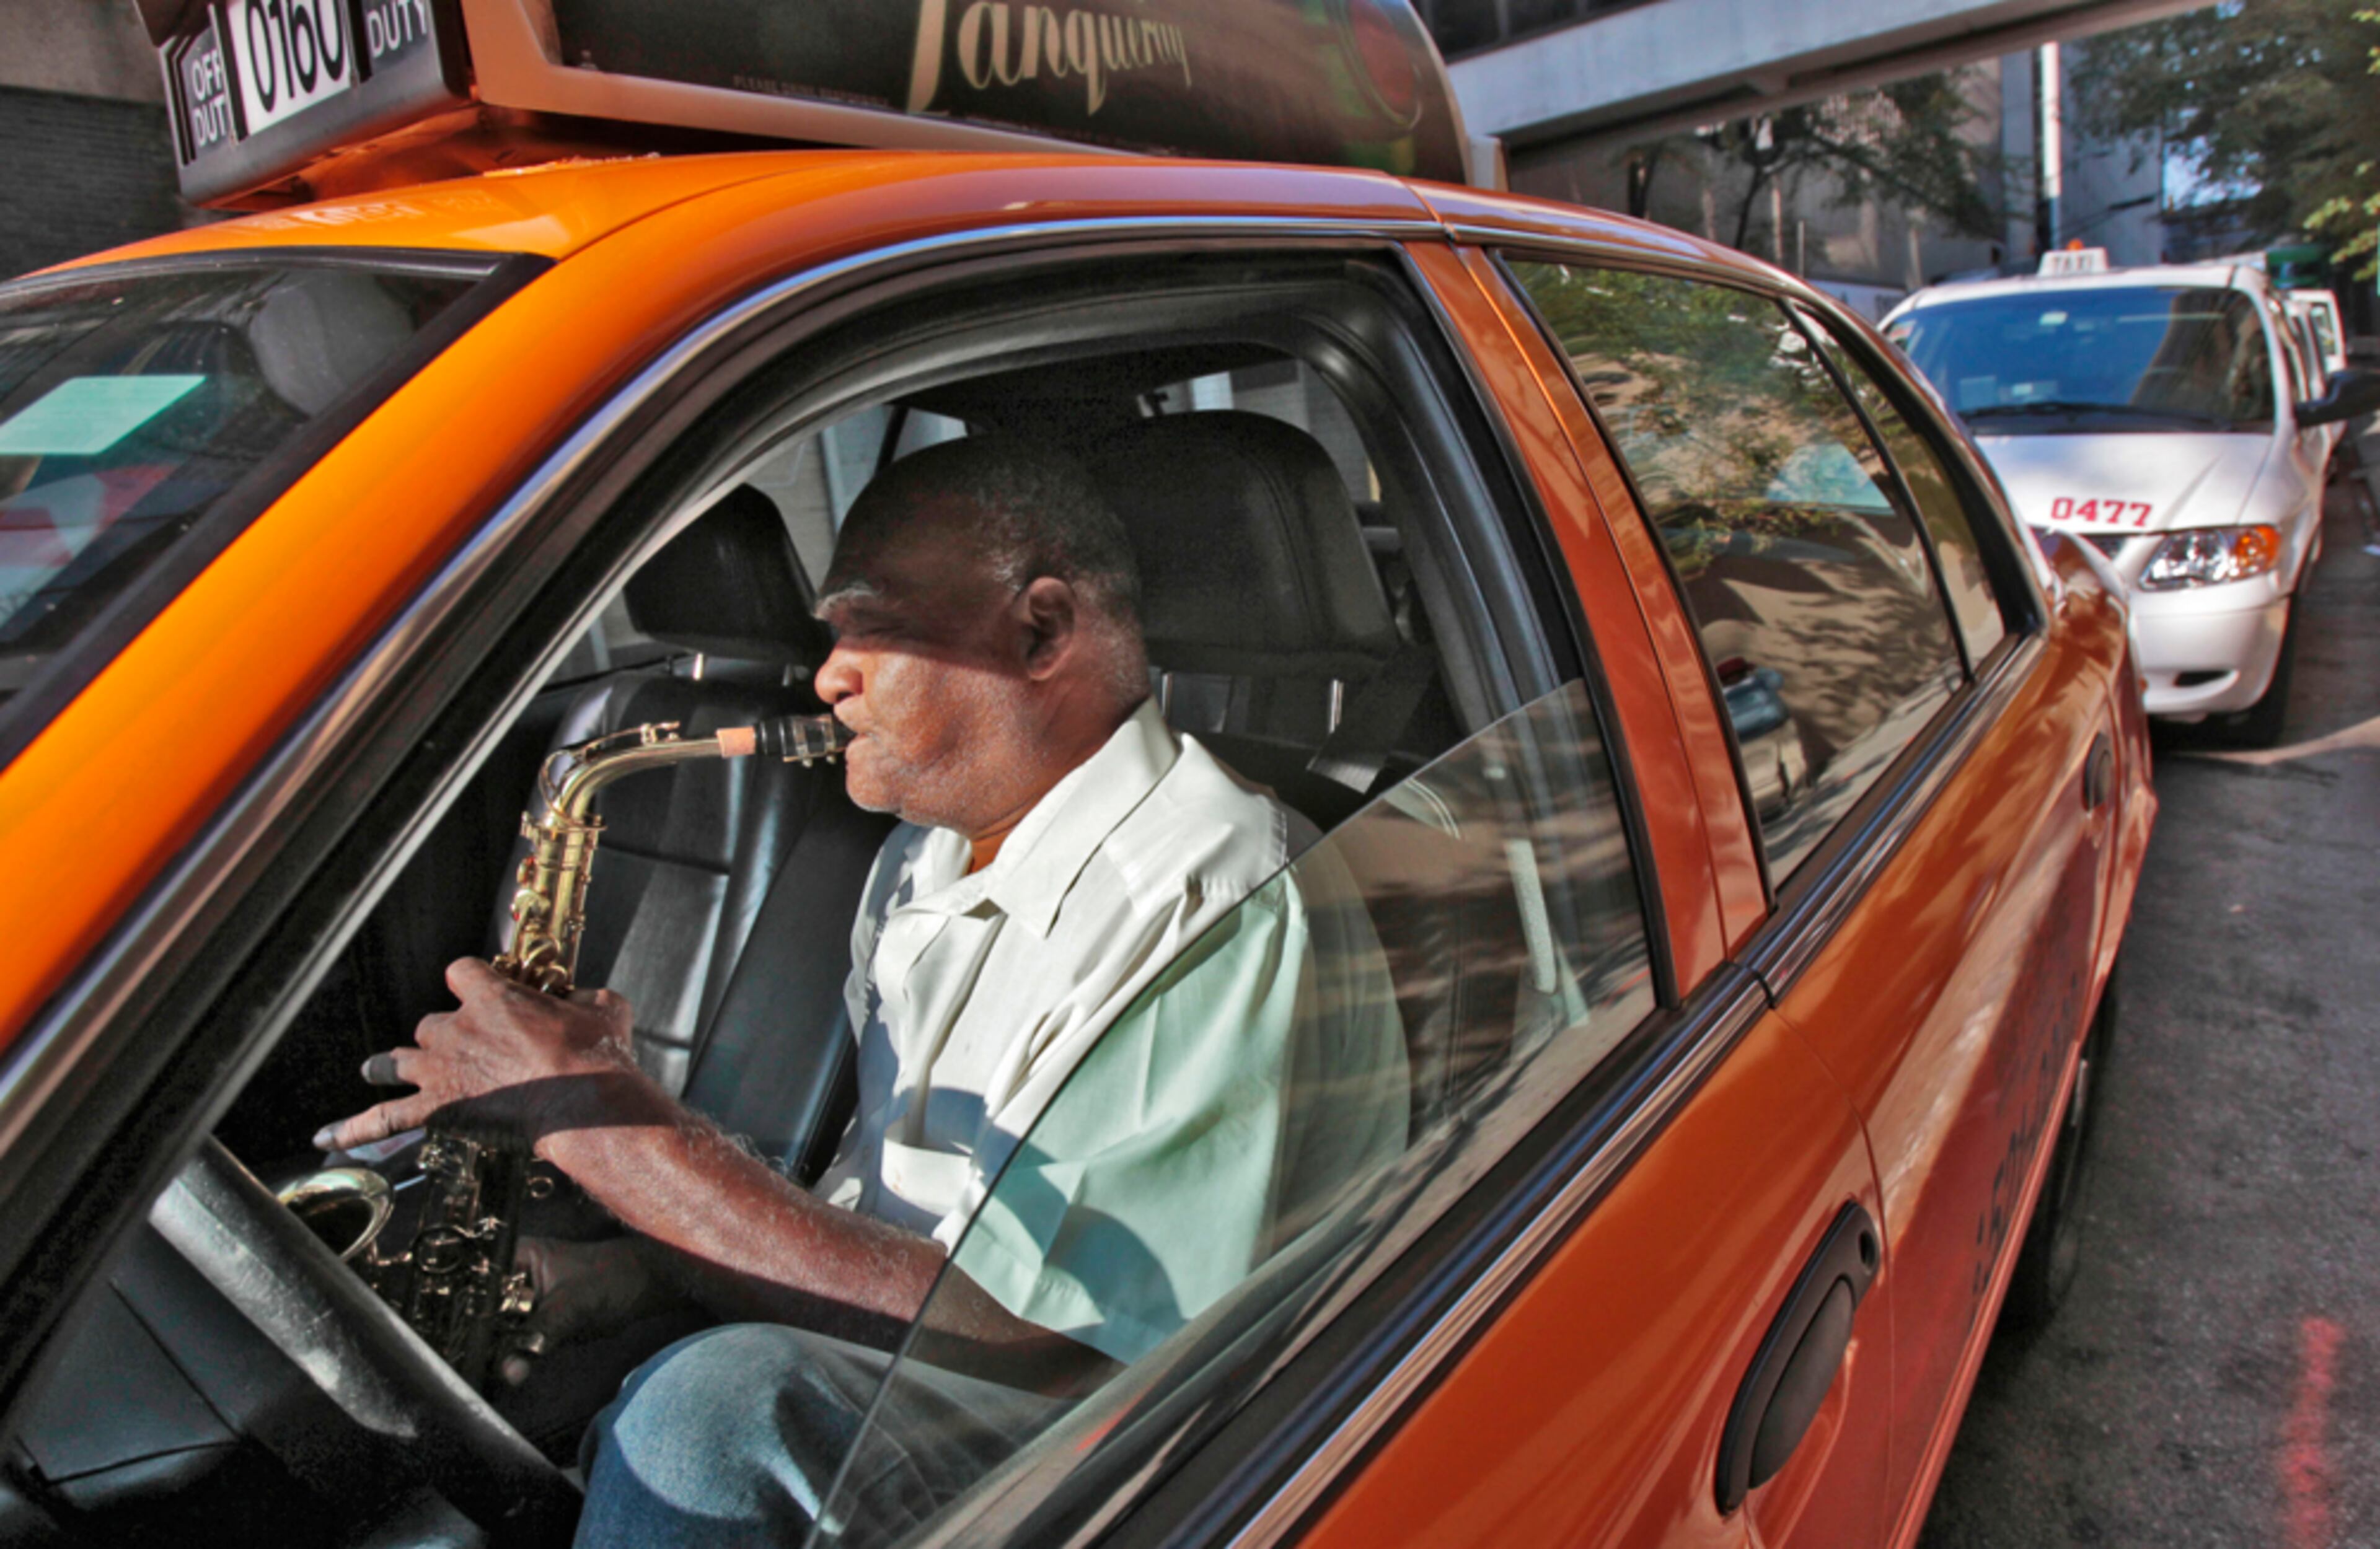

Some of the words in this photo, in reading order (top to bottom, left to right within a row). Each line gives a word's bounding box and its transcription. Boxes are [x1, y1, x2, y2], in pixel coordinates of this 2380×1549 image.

[367, 0, 426, 57] DUTY
[192, 50, 221, 100] OFF
[246, 0, 345, 113] 0160
[193, 93, 227, 146] DUT
[2051, 255, 2092, 271] TAXI
[2052, 497, 2153, 527] 0477
